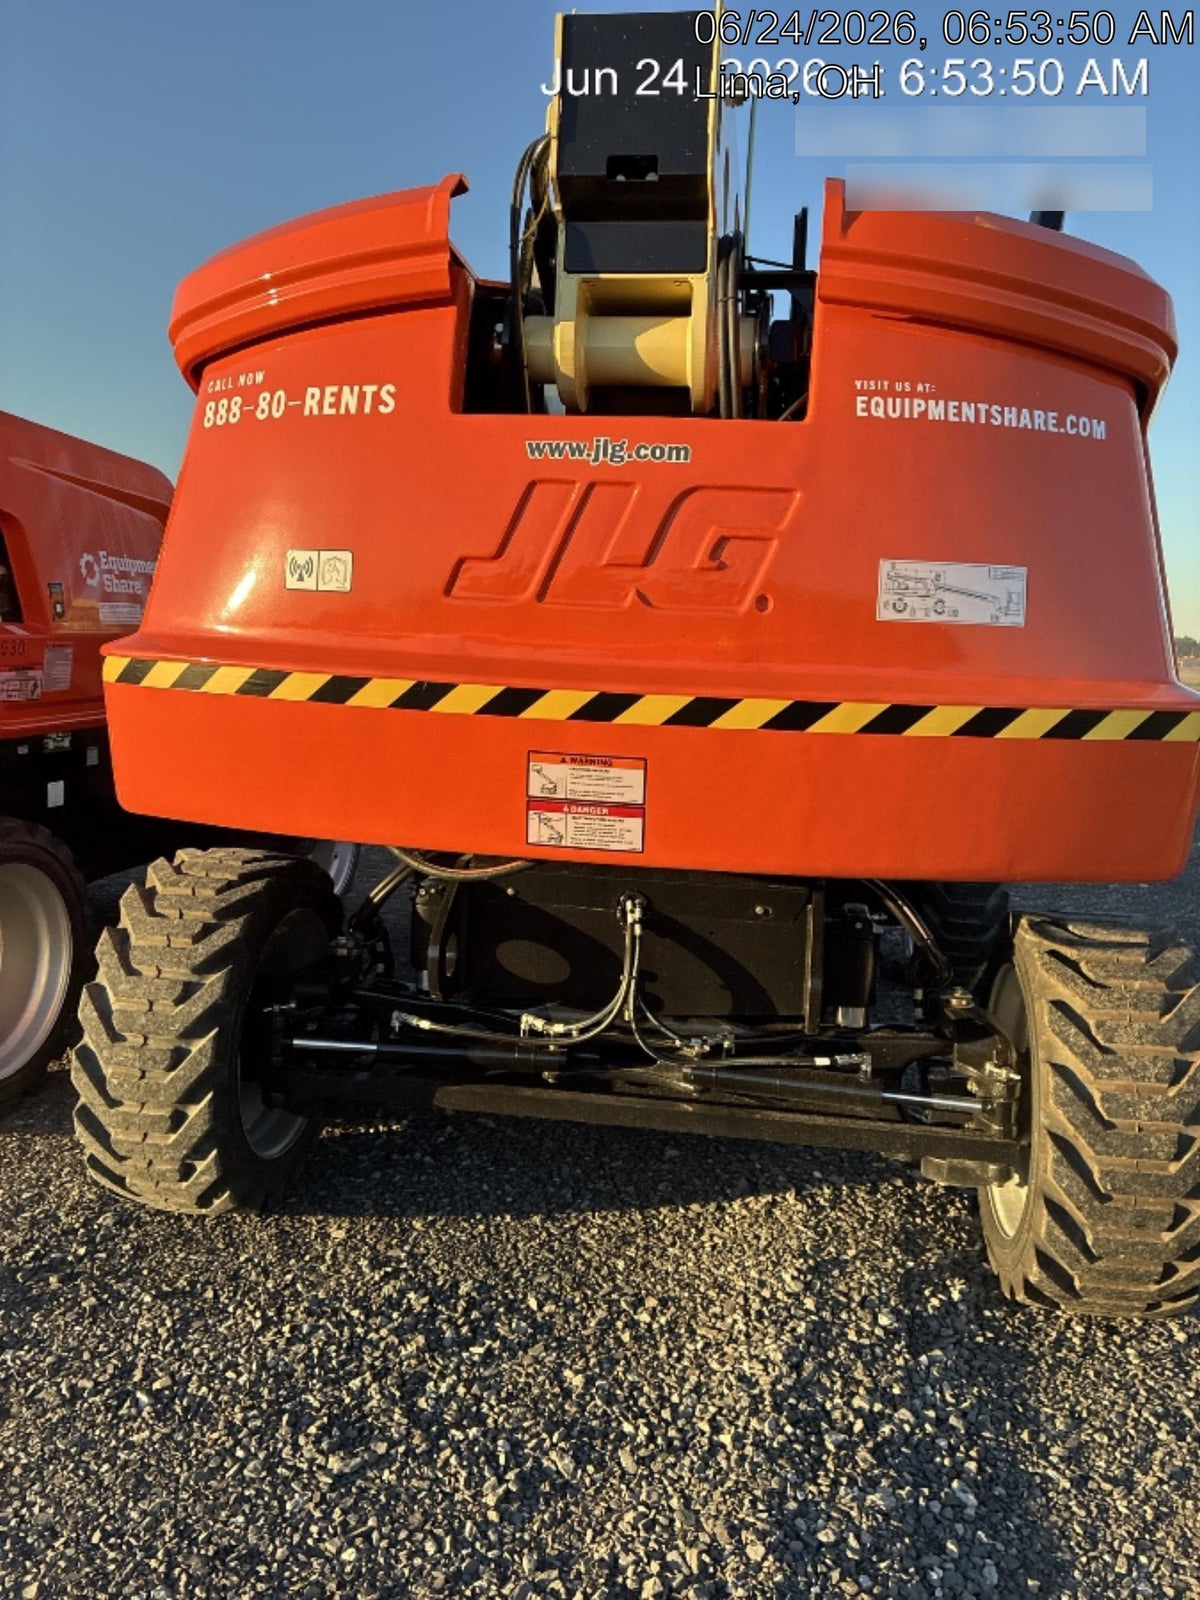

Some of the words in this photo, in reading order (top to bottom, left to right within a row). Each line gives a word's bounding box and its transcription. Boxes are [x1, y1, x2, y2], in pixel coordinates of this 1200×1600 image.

[207, 377, 234, 393] CALL
[238, 371, 265, 386] NOW
[855, 380, 889, 391] VISIT
[895, 381, 911, 392] US
[917, 383, 936, 393] AT:
[203, 384, 396, 428] 888-80-RENTS
[855, 396, 1107, 440] EQUIPMENTSHARE.COM
[526, 437, 691, 466] www.jlg.com
[98, 551, 156, 576] Equipme
[102, 573, 143, 594] Share
[570, 757, 613, 767] WARNING
[570, 805, 609, 815] DANGER
